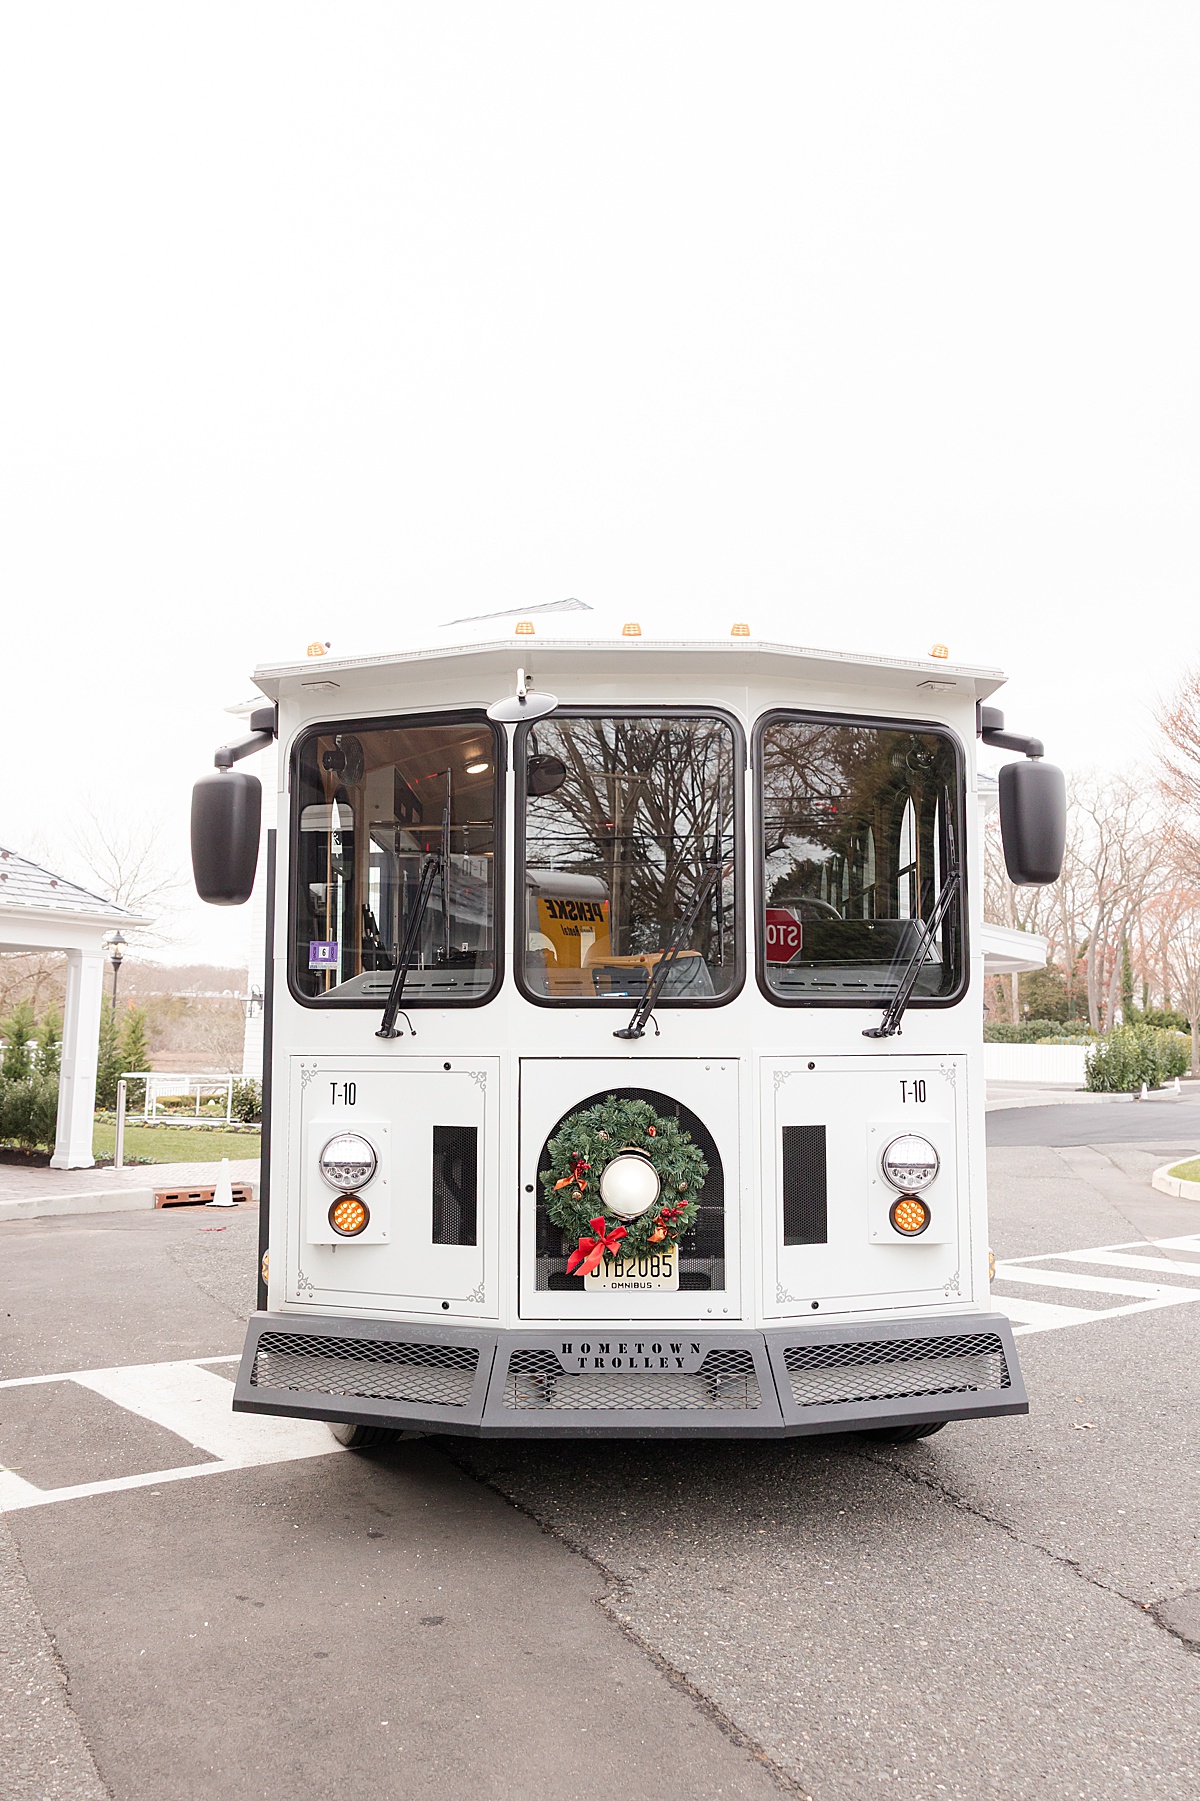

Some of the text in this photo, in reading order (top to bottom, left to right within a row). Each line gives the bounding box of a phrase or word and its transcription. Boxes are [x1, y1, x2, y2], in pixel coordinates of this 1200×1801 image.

[330, 1082, 356, 1105] T-10
[900, 1080, 926, 1103] T-10
[562, 1343, 701, 1354] HOMETOWN
[577, 1357, 685, 1368] TROLLEY
